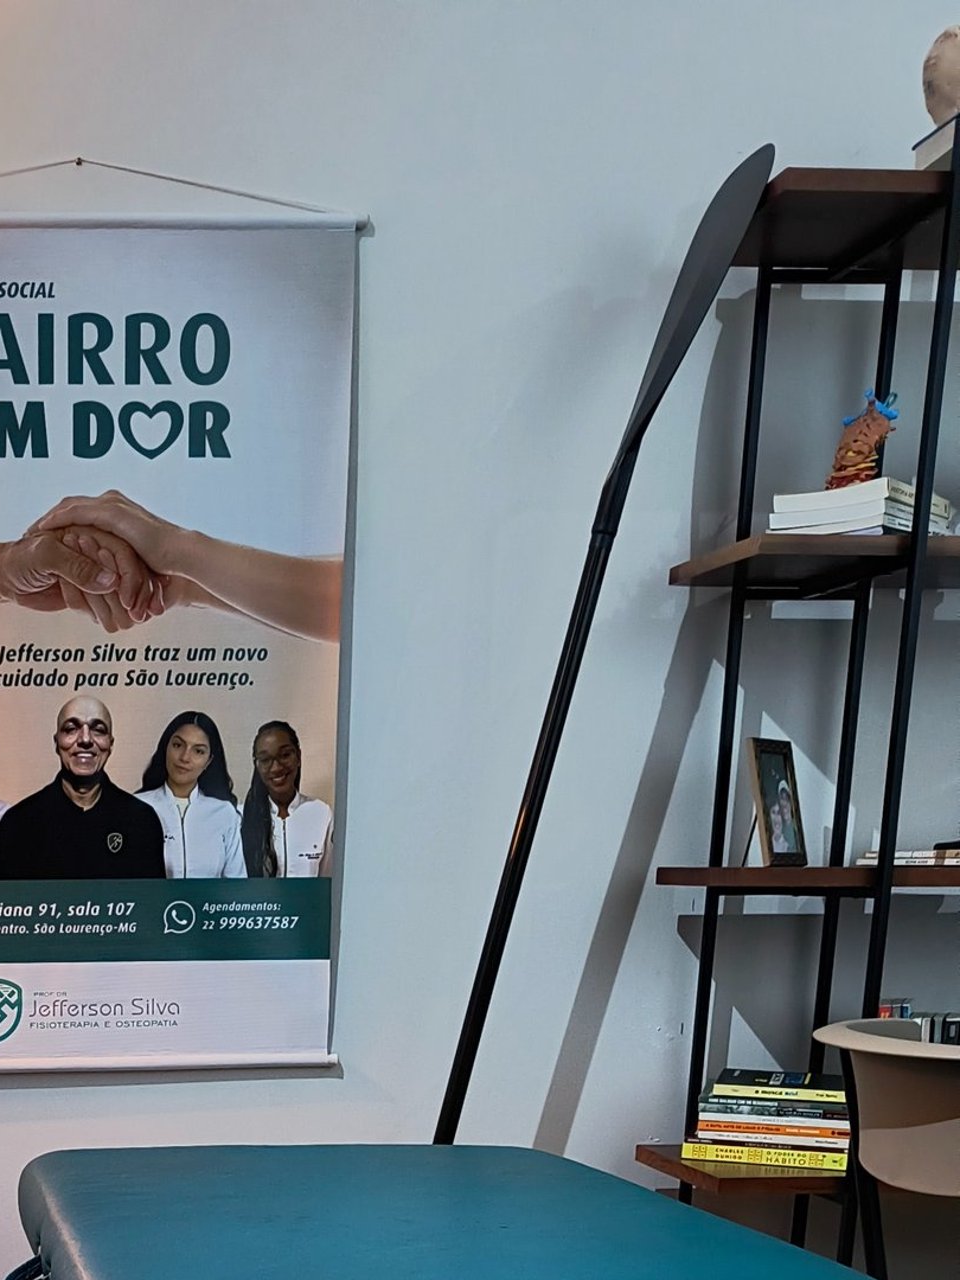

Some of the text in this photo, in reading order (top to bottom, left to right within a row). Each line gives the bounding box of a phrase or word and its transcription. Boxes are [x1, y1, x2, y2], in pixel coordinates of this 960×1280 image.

[90, 644, 137, 662] Silva
[143, 645, 180, 662] traz
[186, 647, 216, 661] um
[222, 647, 269, 662] novo
[74, 671, 118, 691] para
[125, 669, 160, 686] São
[165, 669, 255, 691] Lourenço.
[38, 903, 61, 919] 91,
[67, 901, 99, 917] sala
[106, 902, 135, 916] 107
[202, 901, 281, 914] Agendamentos:
[34, 922, 55, 934] São
[59, 922, 136, 936] Lourenço-MG
[202, 916, 299, 930] 22 999637587
[29, 998, 180, 1017] Jefferson Silva
[30, 1021, 99, 1029] FISIOTERAPIA
[116, 1020, 178, 1028] OSTEOPATIA
